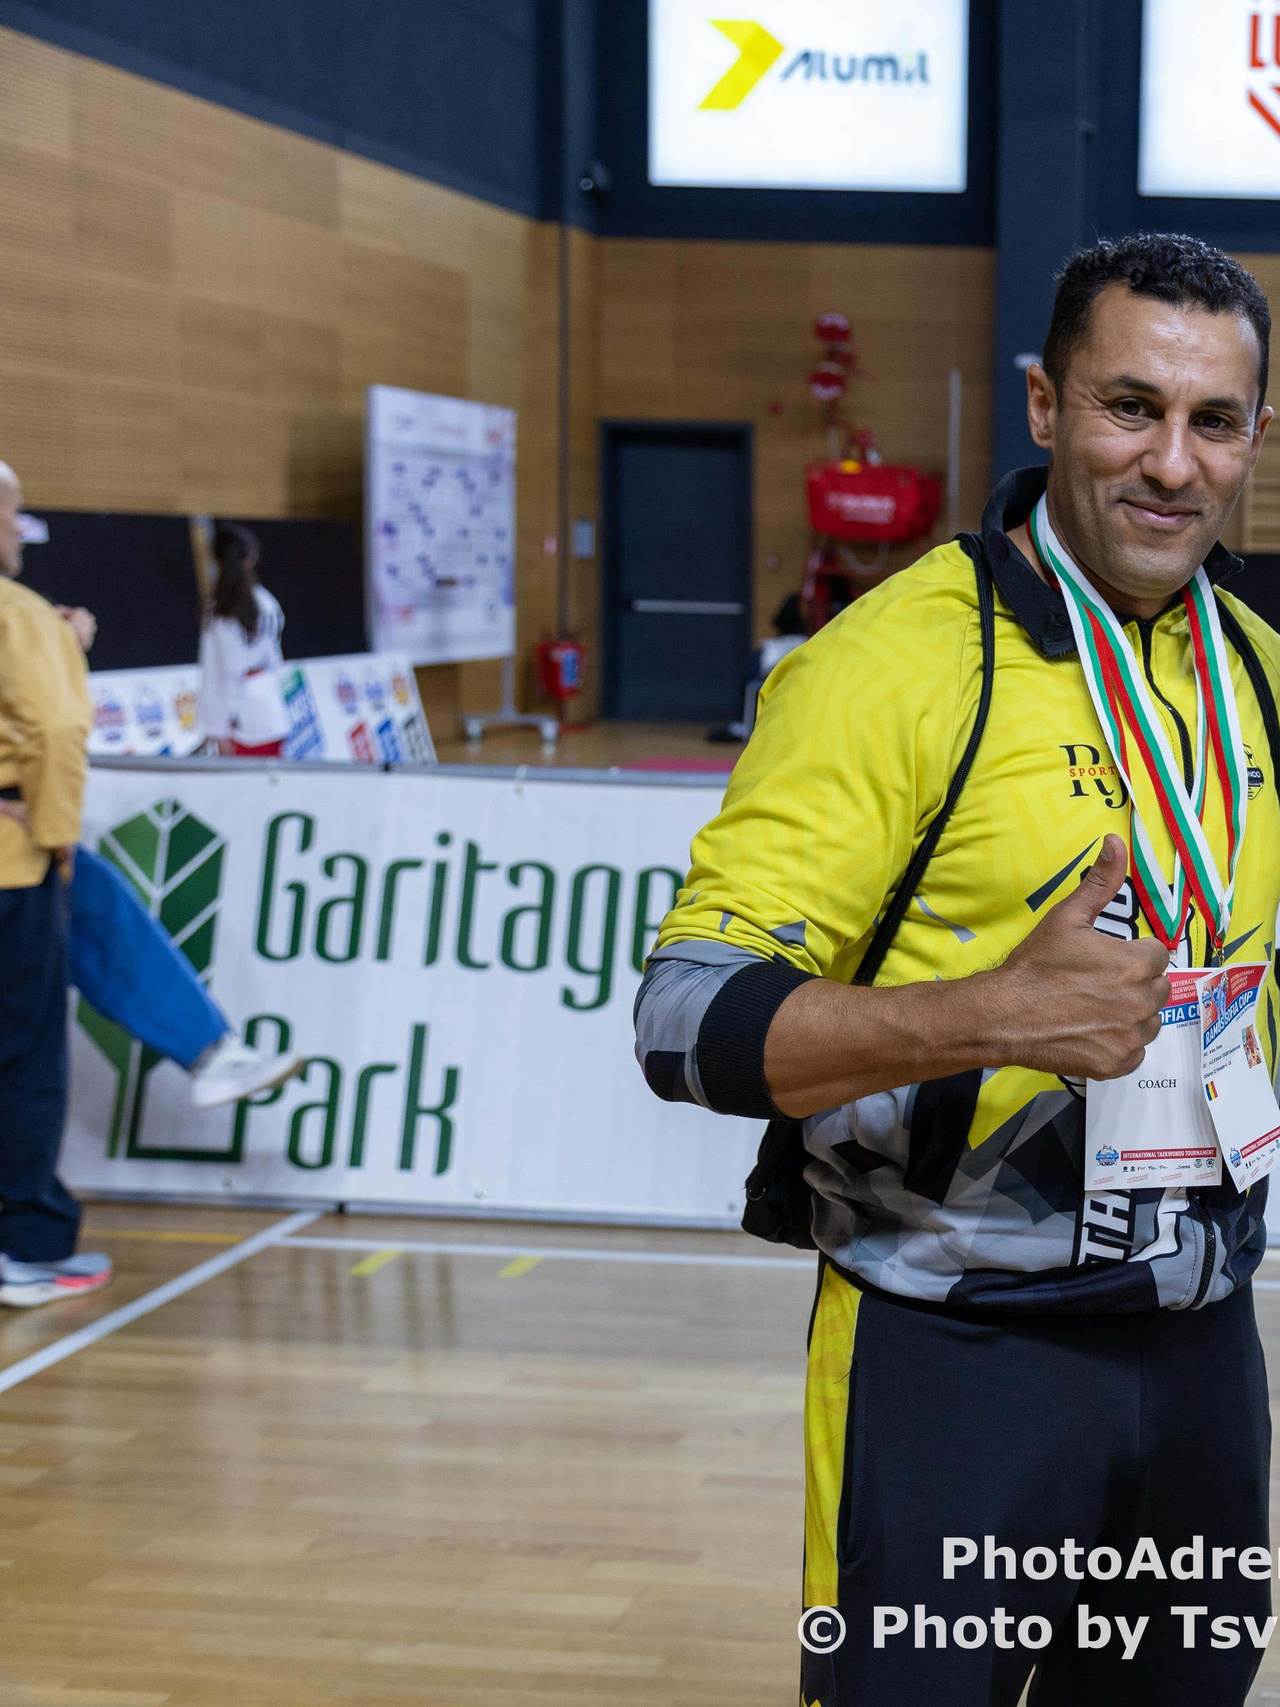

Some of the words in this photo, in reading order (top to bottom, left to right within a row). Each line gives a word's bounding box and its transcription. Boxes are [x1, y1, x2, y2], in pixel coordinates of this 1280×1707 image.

[780, 50, 929, 83] Alumil
[1069, 766, 1116, 777] SPORT
[255, 811, 687, 1012] Garitage
[1171, 991, 1199, 1001] TOURNAME
[1238, 990, 1254, 1009] CUP
[1138, 1078, 1177, 1090] COACH
[237, 1014, 462, 1178] Park
[1123, 1151, 1157, 1159] INTERNATIONAL
[1157, 1150, 1185, 1158] TAEKWONDO
